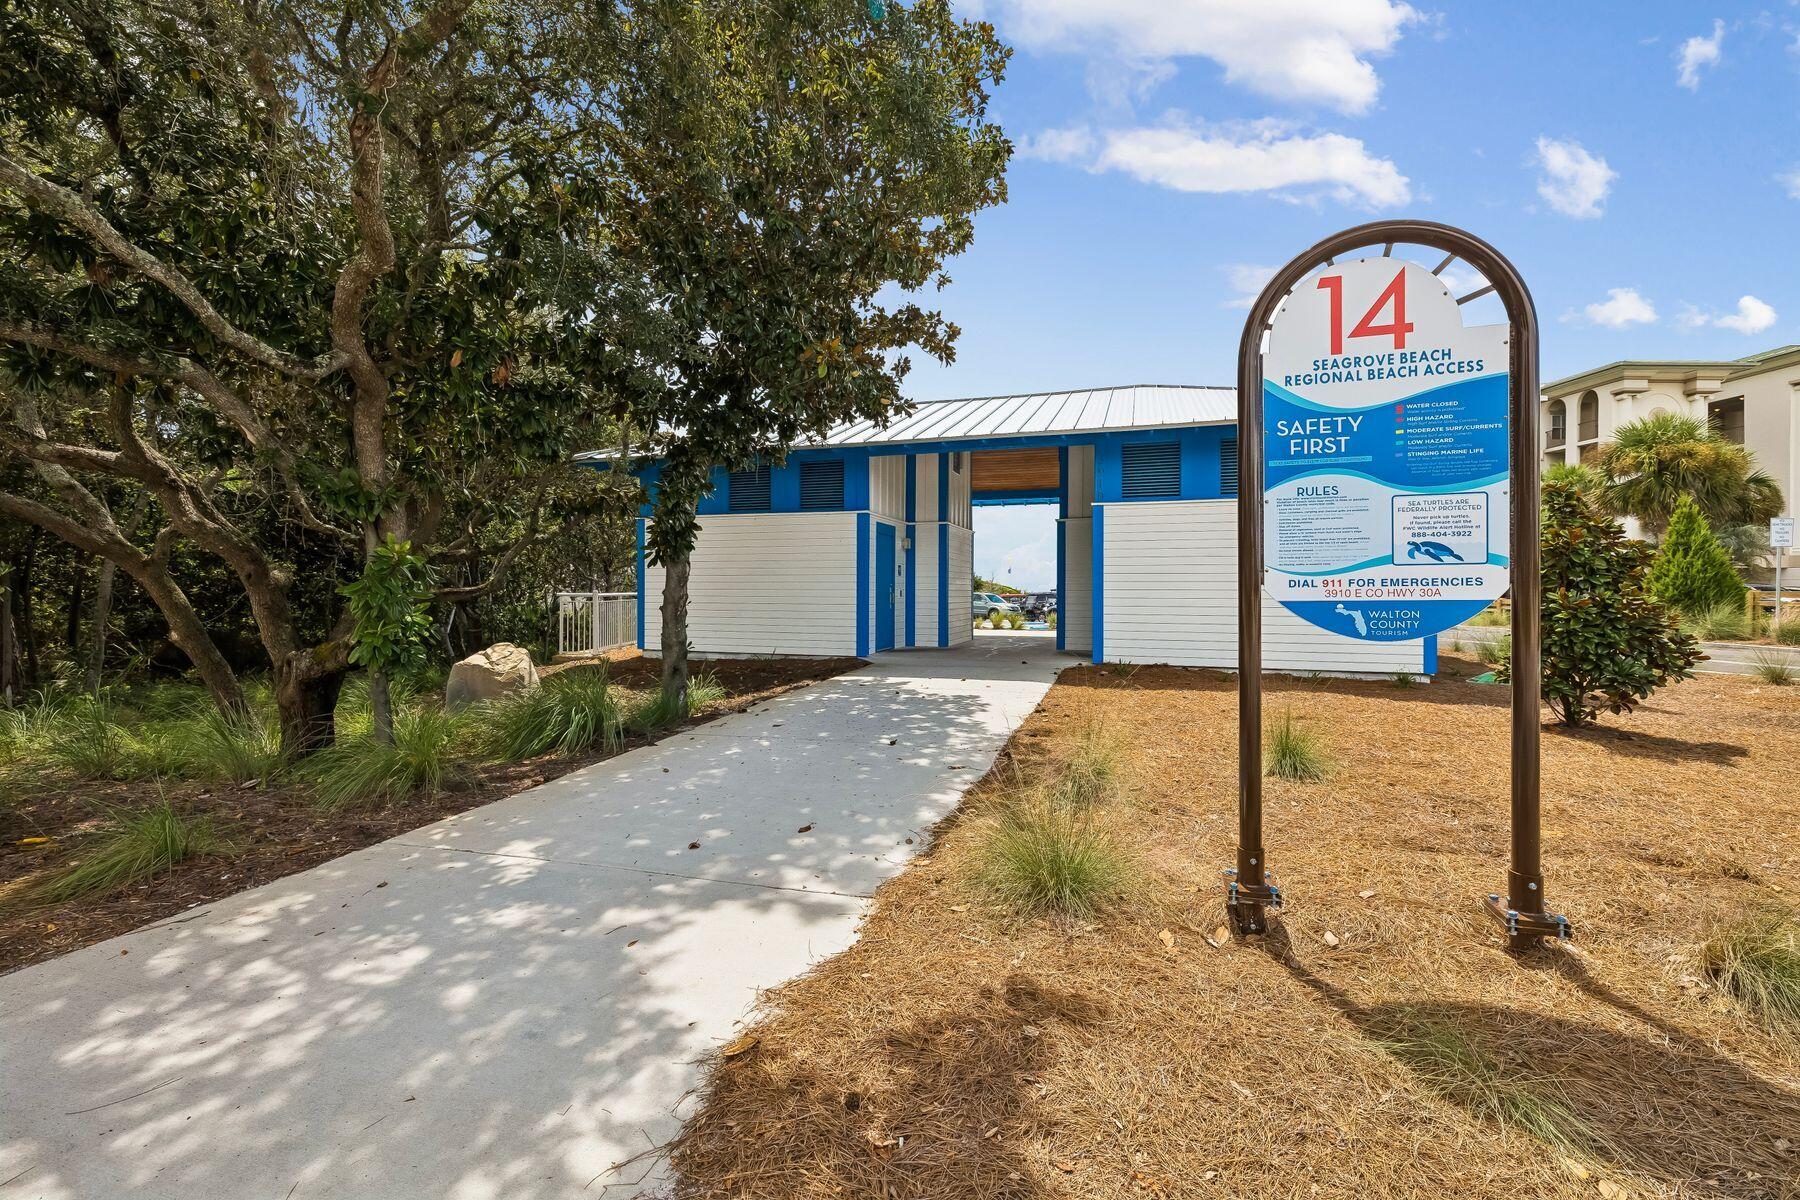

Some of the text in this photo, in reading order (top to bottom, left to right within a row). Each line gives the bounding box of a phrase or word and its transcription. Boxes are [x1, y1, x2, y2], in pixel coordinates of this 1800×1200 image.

[1317, 266, 1414, 355] 14
[1313, 348, 1452, 371] SEAGROVE BEACH
[1284, 359, 1484, 387] REGIONAL BEACH ACCESS
[1276, 415, 1364, 436] SAFETY
[1445, 423, 1503, 431] SURF/CURRENTS
[1290, 437, 1350, 455] FIRST
[1297, 485, 1339, 496] RULES
[1288, 577, 1484, 588] DIAL 911 FOR EMERGENCIES
[1324, 588, 1442, 598] 3910 E CO HWY 30A
[1368, 610, 1420, 619] WALTON
[1370, 620, 1420, 629] COUNTY
